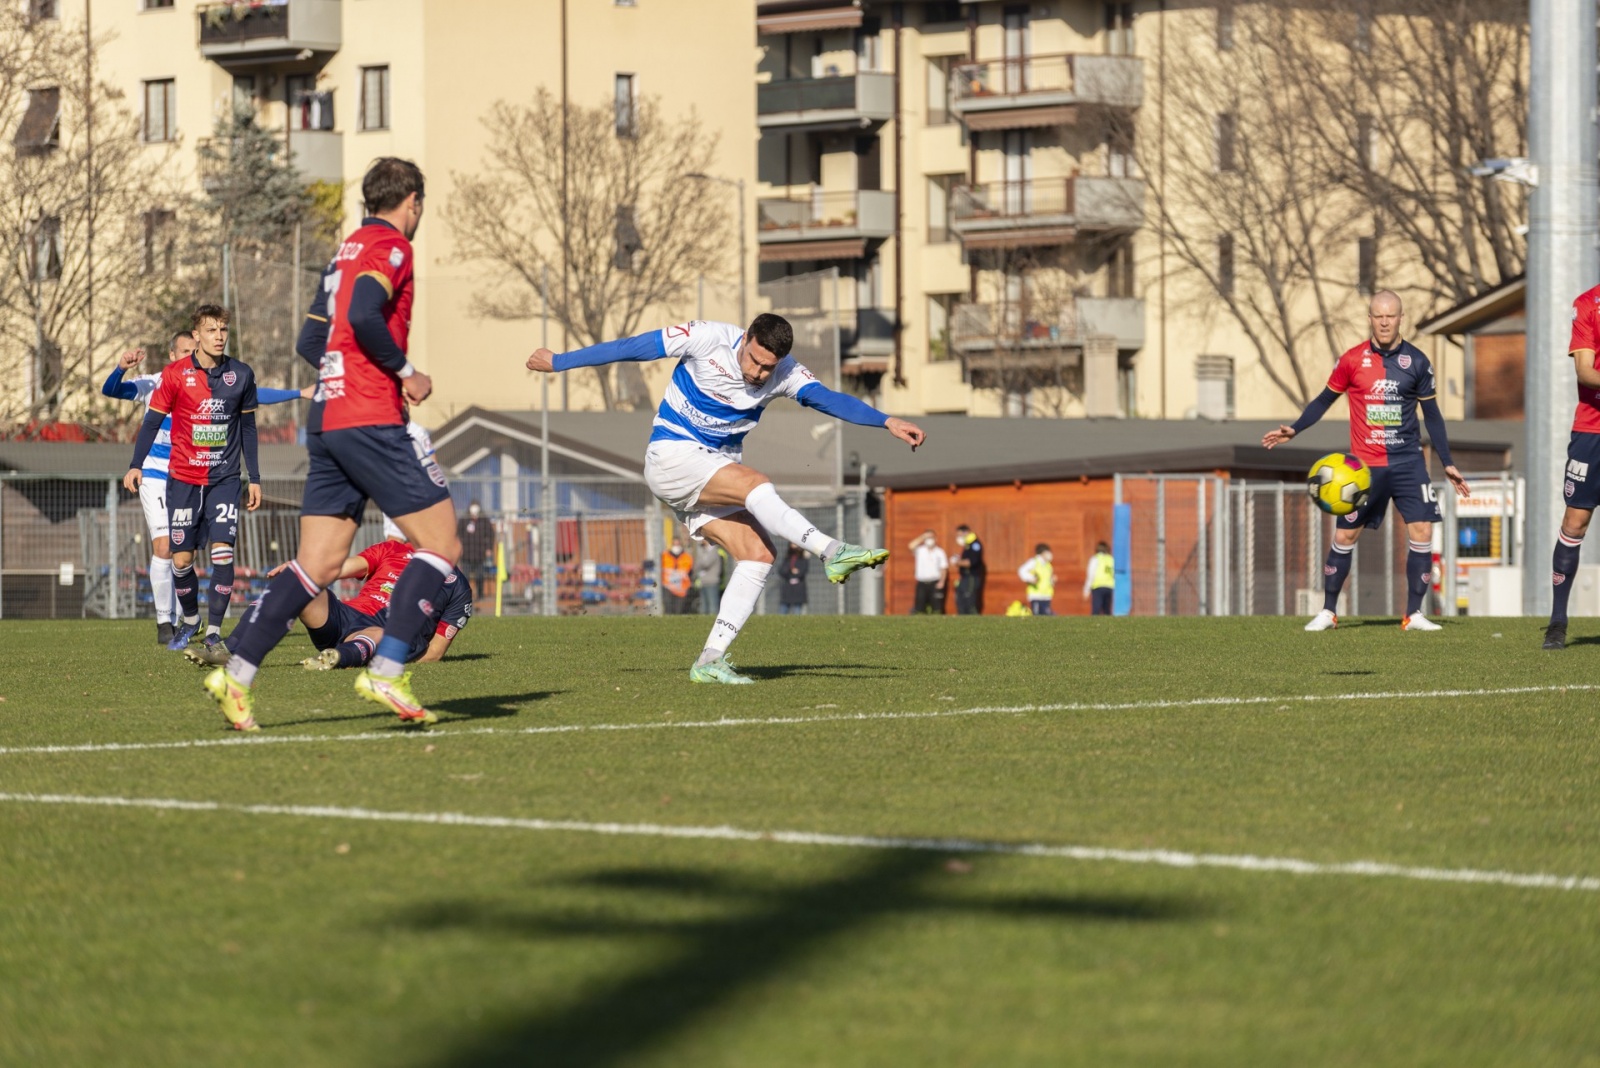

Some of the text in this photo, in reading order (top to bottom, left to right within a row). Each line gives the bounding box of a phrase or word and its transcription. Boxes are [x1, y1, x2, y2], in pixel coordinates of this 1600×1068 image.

[1368, 411, 1401, 421] GARDA
[193, 431, 227, 441] GARDA
[1421, 483, 1438, 503] 16
[215, 503, 238, 524] 24
